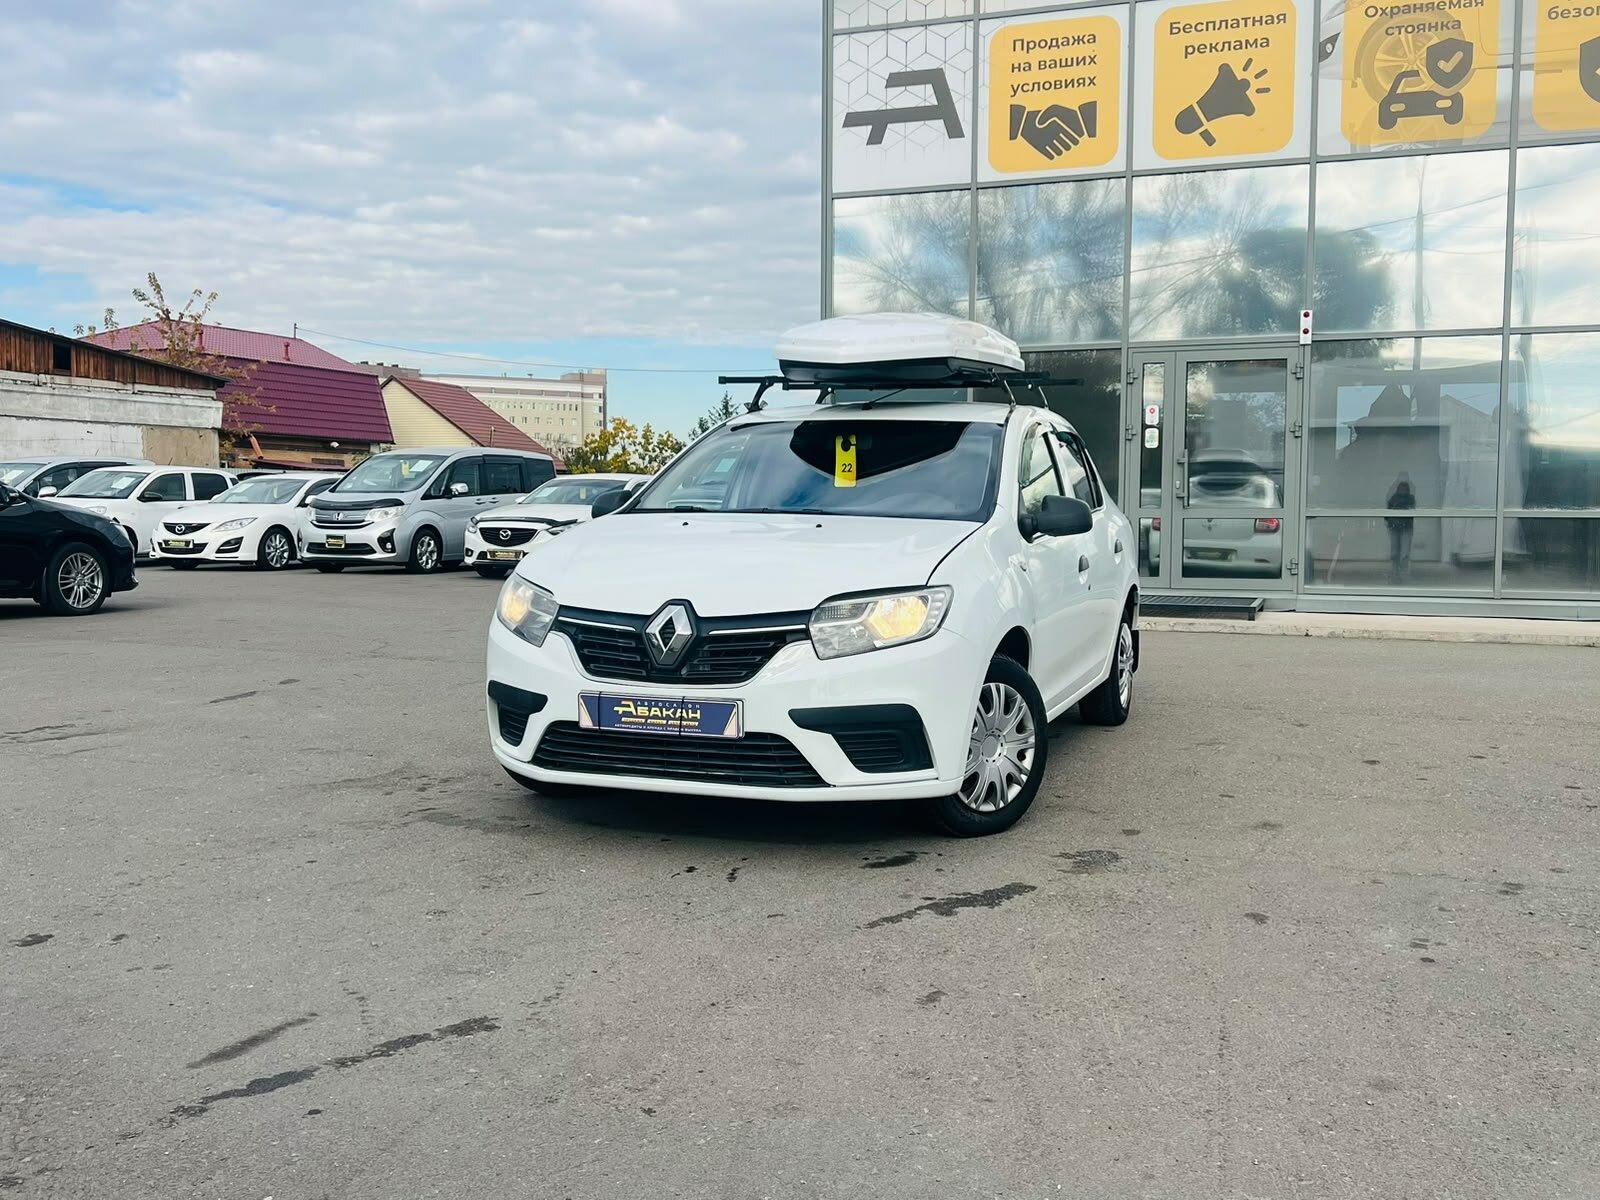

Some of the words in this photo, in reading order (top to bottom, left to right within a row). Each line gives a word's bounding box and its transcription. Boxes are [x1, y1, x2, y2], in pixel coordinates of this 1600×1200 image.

[1364, 0, 1484, 18] Охраняемая
[1169, 12, 1287, 35] Бесплатная
[1385, 19, 1462, 36] стоянка
[1012, 33, 1097, 54] Продажа
[1184, 37, 1270, 59] реклама
[1011, 61, 1032, 73] на
[1038, 54, 1097, 71] ваших
[1010, 76, 1097, 98] условиях
[841, 462, 853, 473] 22
[636, 701, 701, 709] АВТОСАОН
